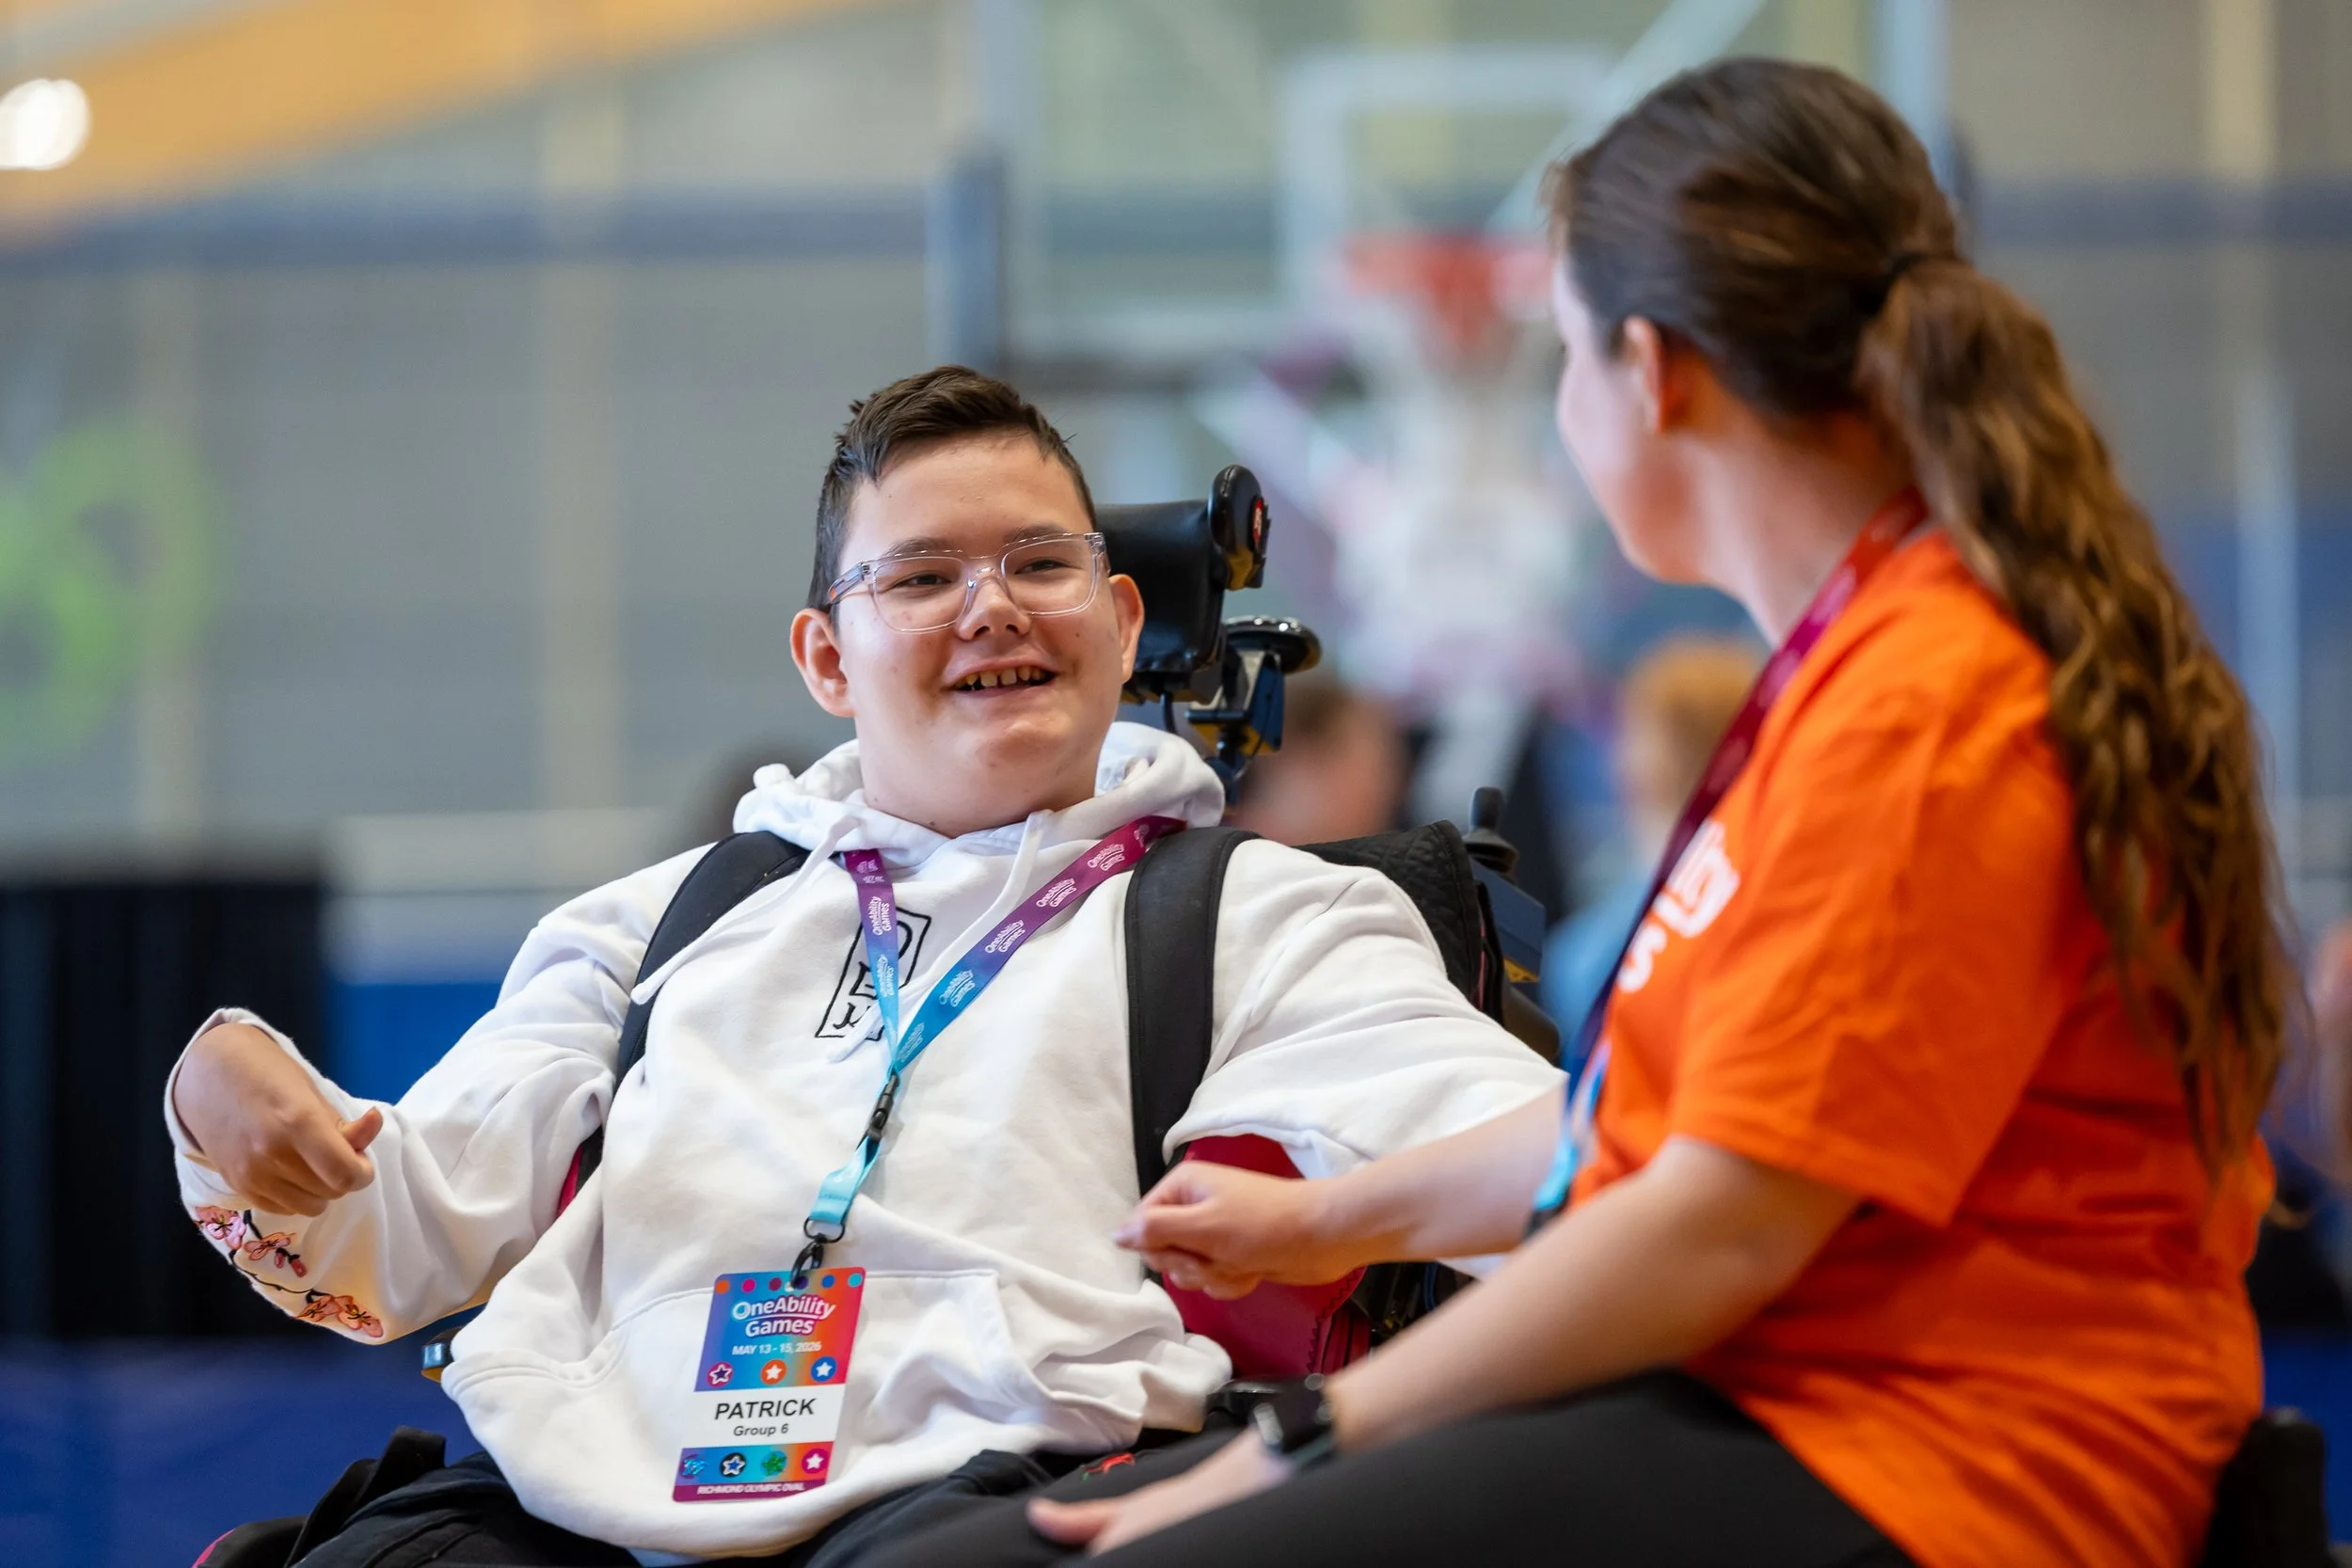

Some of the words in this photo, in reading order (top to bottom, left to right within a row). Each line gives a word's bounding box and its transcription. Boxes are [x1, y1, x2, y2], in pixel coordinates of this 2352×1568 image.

[1087, 844, 1124, 868] OneAbility
[1100, 853, 1125, 871] Games
[1036, 878, 1075, 907] OneAbility
[1049, 886, 1077, 907] Games
[868, 895, 882, 935] OneAbility
[881, 902, 892, 931] Games
[984, 920, 1024, 953] OneAbility
[998, 928, 1025, 953] Games
[939, 969, 974, 1005] OneAbility
[950, 980, 976, 1006] Games
[732, 1296, 836, 1321] OneAbility
[745, 1319, 815, 1337] Games
[732, 1344, 757, 1355] MAY
[759, 1343, 771, 1354] 13
[780, 1342, 794, 1354] 15,
[715, 1398, 817, 1420] PATRICK
[733, 1424, 776, 1436] Group
[781, 1423, 788, 1434] 6
